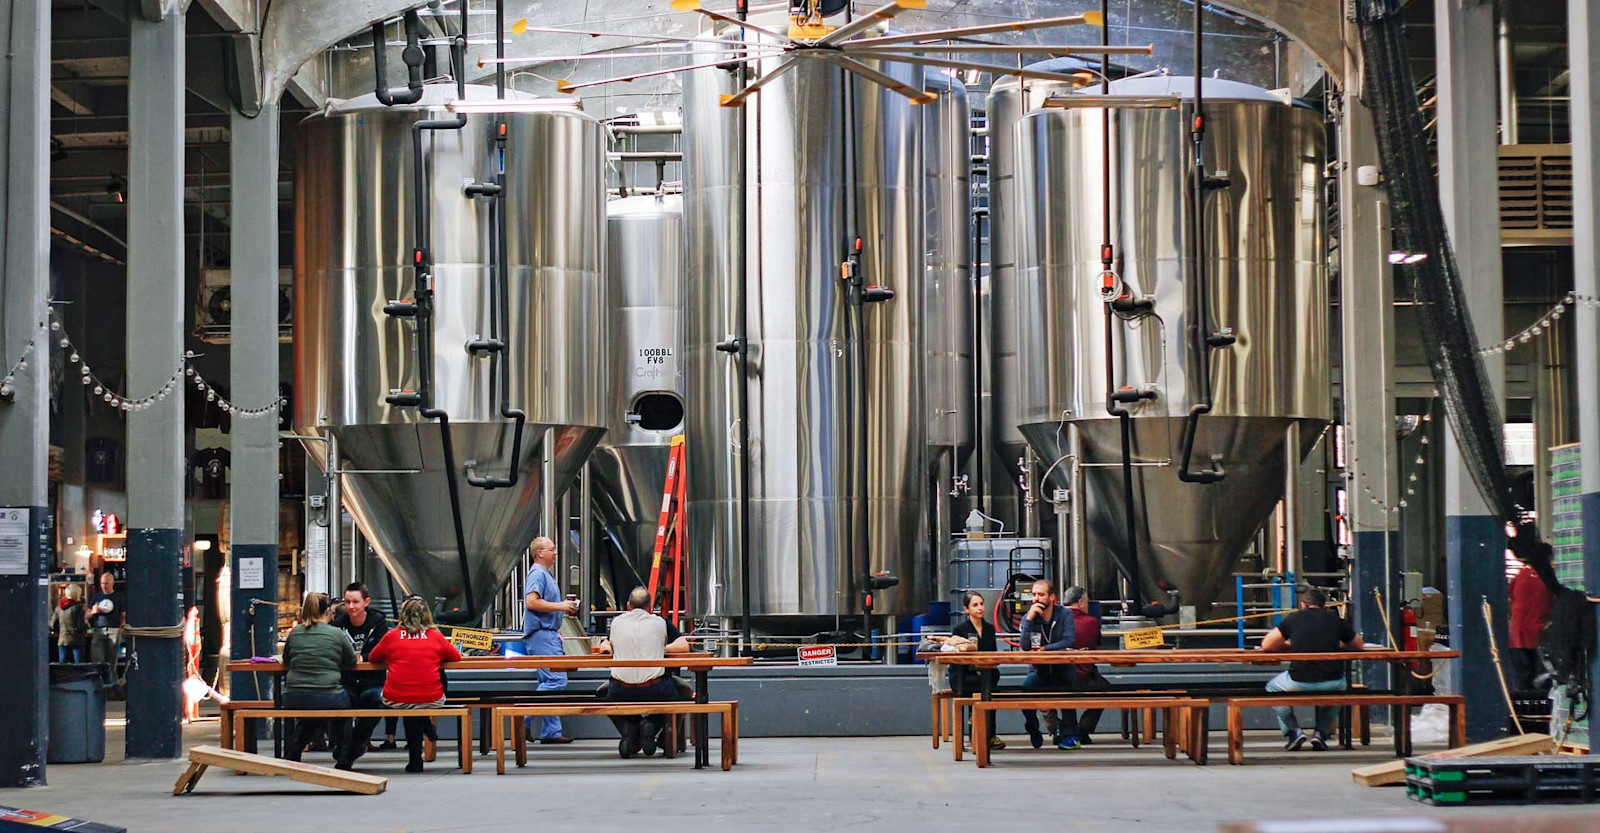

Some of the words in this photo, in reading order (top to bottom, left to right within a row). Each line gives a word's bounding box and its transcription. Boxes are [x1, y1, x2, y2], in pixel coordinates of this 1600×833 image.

[640, 348, 672, 356] 100BBL
[456, 633, 489, 642] AUTHORIZED
[802, 649, 831, 657] DANGER
